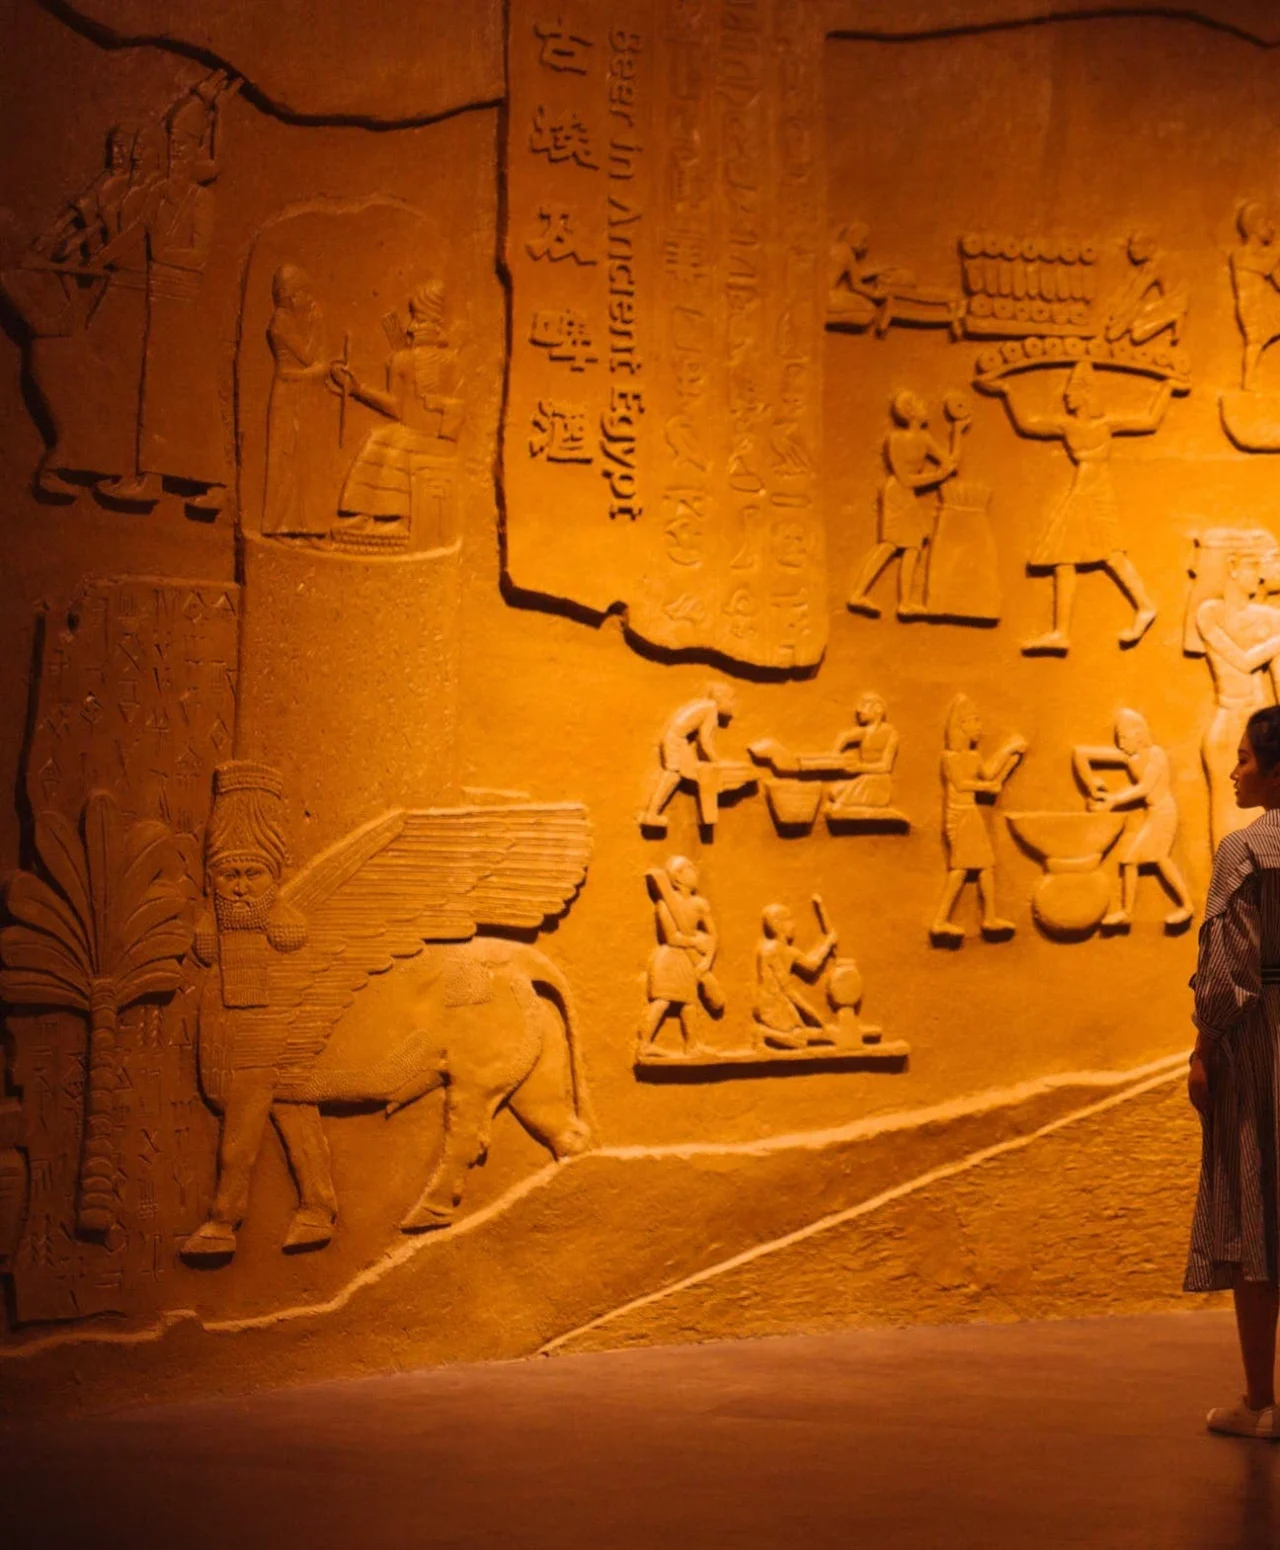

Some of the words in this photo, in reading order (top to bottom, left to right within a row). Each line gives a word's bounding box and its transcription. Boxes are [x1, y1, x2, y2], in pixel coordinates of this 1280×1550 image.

[607, 24, 642, 128] Beer
[608, 142, 644, 181] in
[526, 16, 600, 464] 古埃及啤酒
[607, 196, 645, 375] Ancient
[600, 386, 646, 522] Egypt
